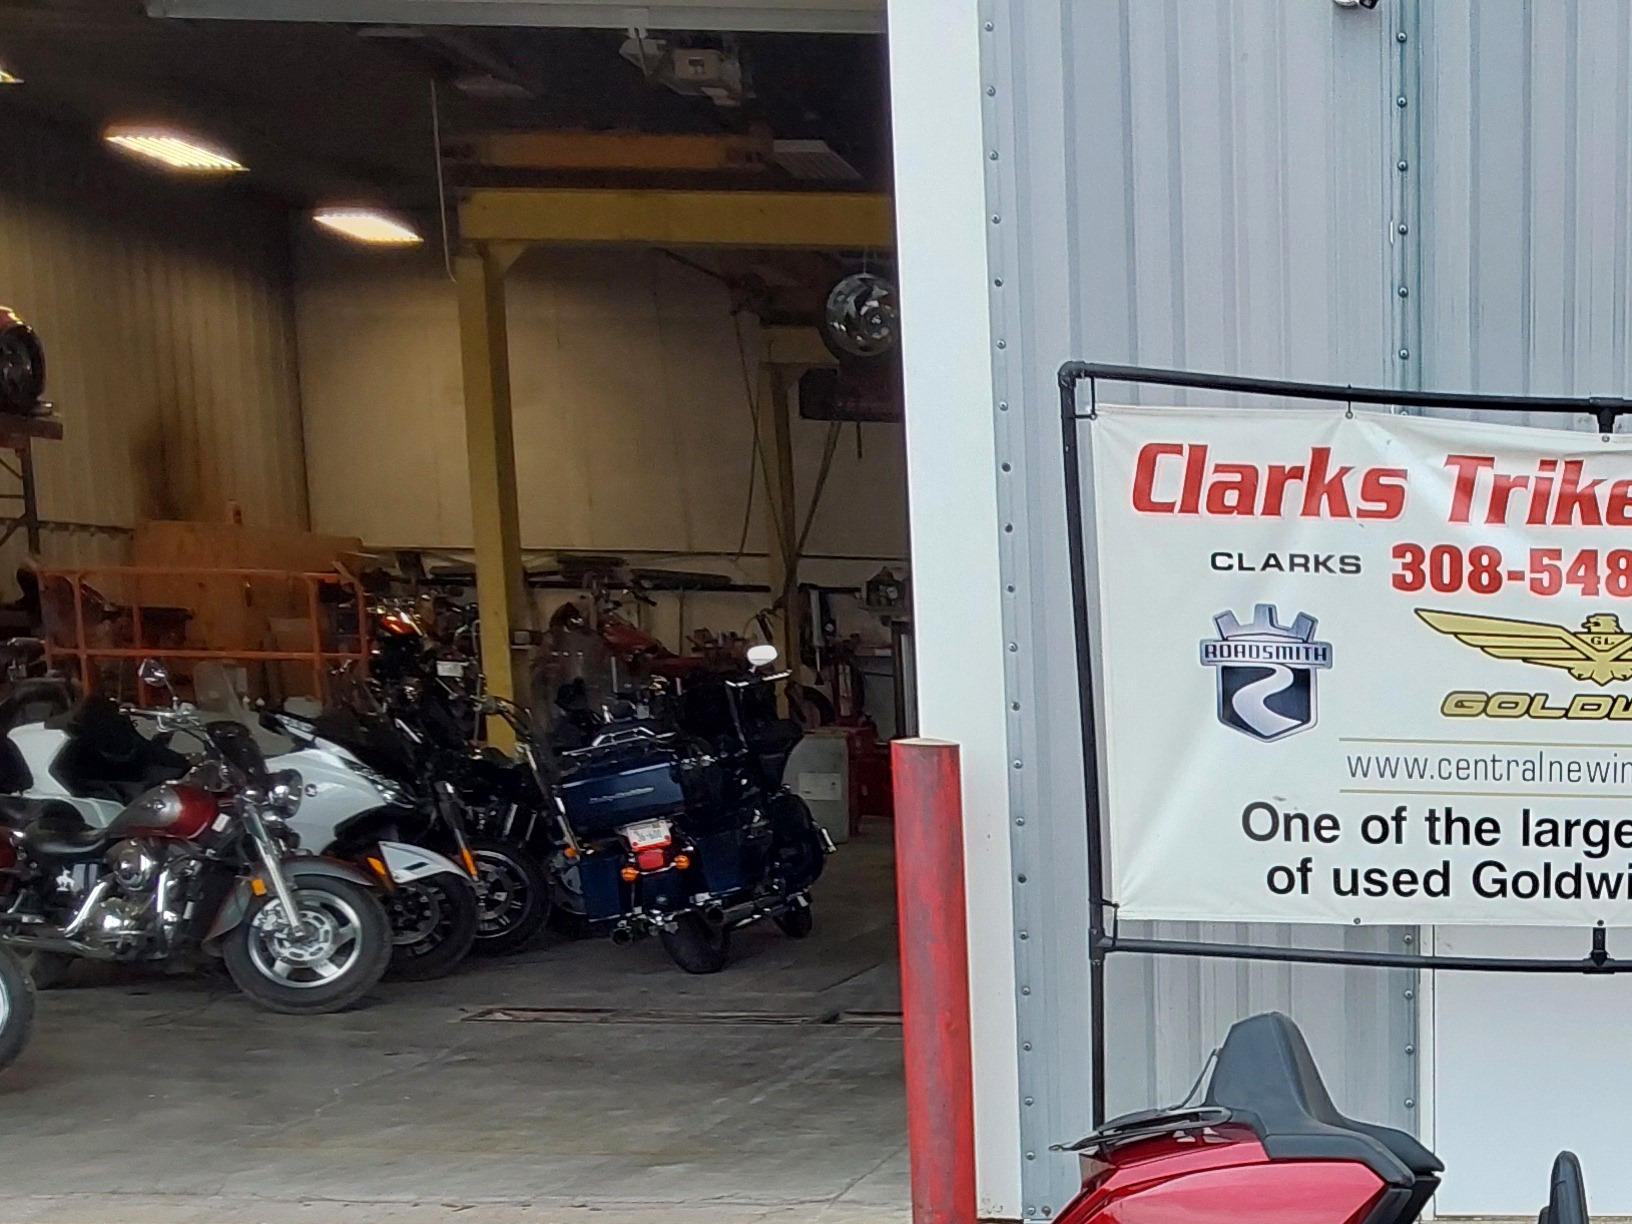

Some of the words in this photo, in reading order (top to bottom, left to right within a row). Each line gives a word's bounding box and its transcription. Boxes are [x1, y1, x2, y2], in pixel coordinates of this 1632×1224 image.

[1132, 443, 1408, 520] Clarks
[1210, 552, 1362, 575] CLARKS
[1204, 644, 1328, 661] ROADSMITH
[1591, 636, 1615, 645] GL
[1242, 801, 1340, 843] One
[1361, 806, 1407, 845] of
[1425, 806, 1501, 846] the
[1266, 857, 1313, 895] of
[1333, 859, 1451, 898] used
